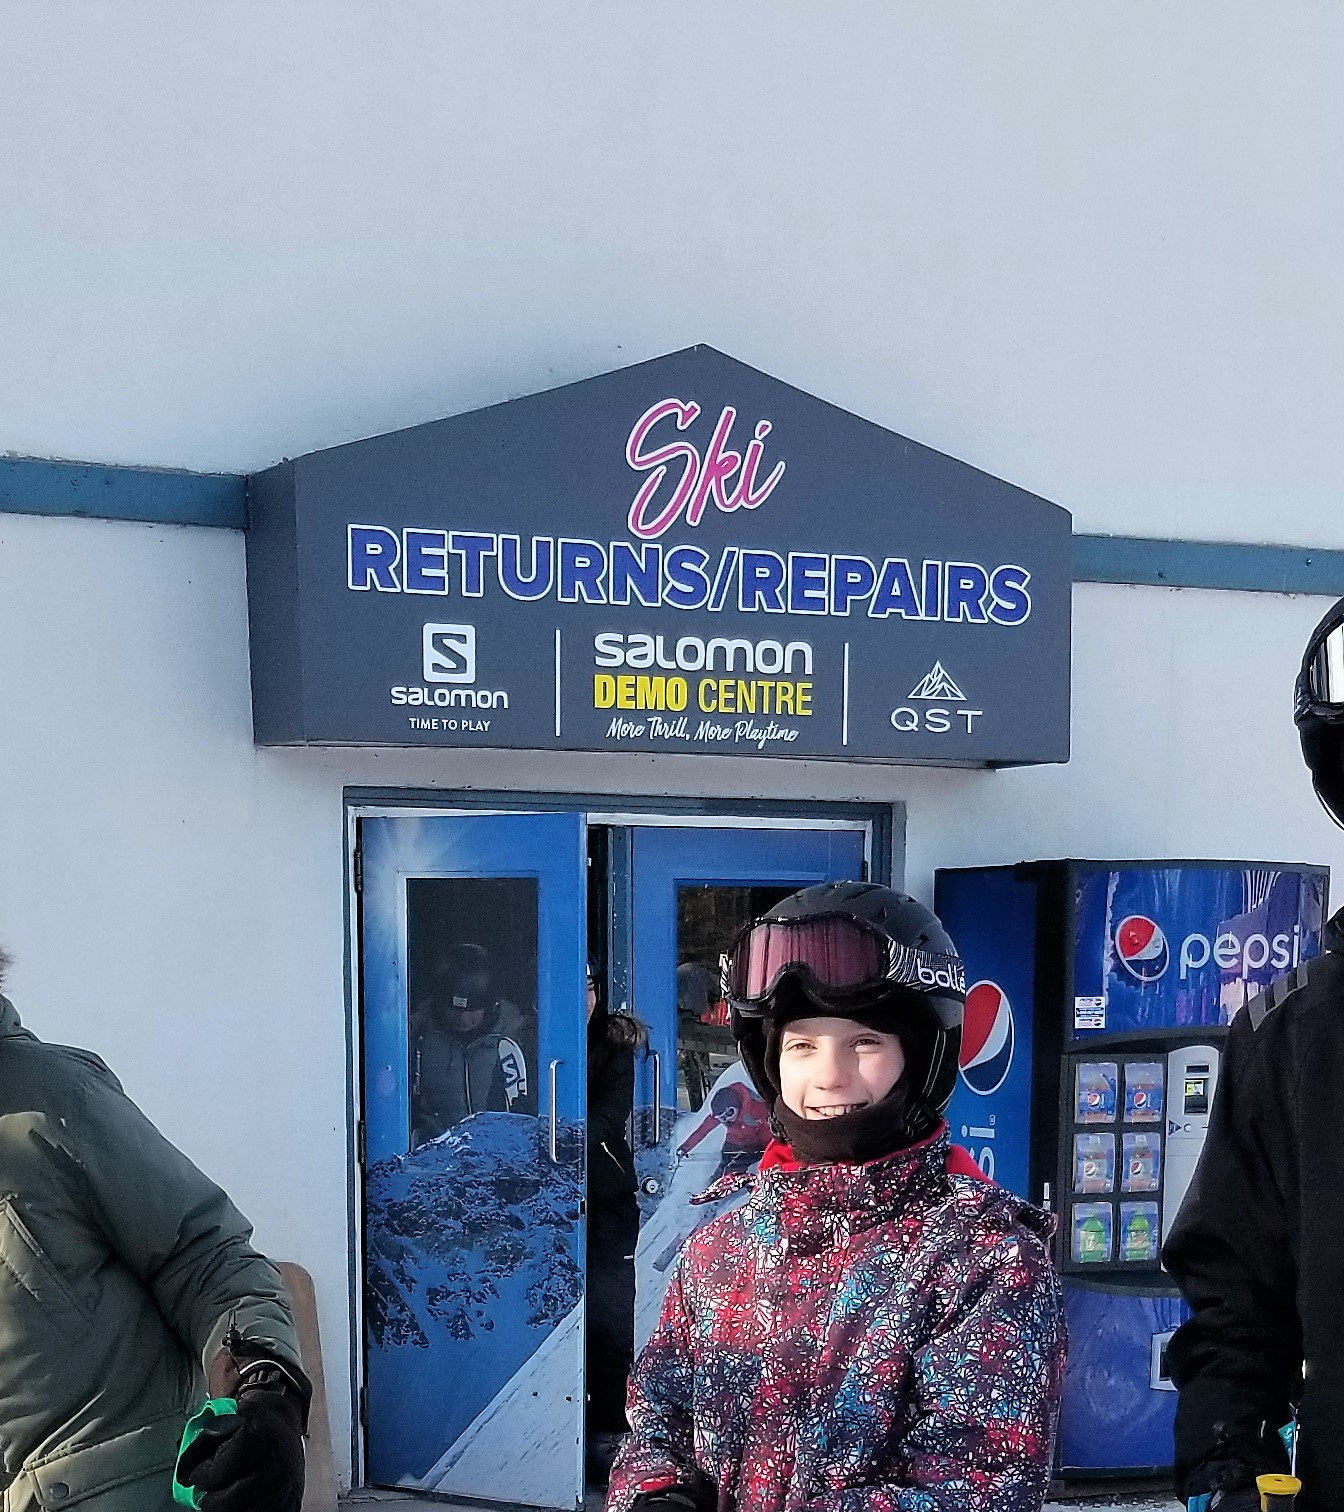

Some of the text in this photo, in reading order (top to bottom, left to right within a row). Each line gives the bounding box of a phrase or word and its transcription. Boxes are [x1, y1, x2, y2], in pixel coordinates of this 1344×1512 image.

[626, 397, 787, 539] Ski
[347, 523, 1033, 627] RETURNS/REPAIRS
[594, 674, 814, 716] DEMO CENTRE
[409, 717, 491, 732] TIME TO PLAY
[606, 717, 645, 740] More
[694, 720, 731, 742] More
[734, 717, 800, 750] Playtime
[890, 707, 983, 734] QST
[1179, 925, 1300, 979] pepsi
